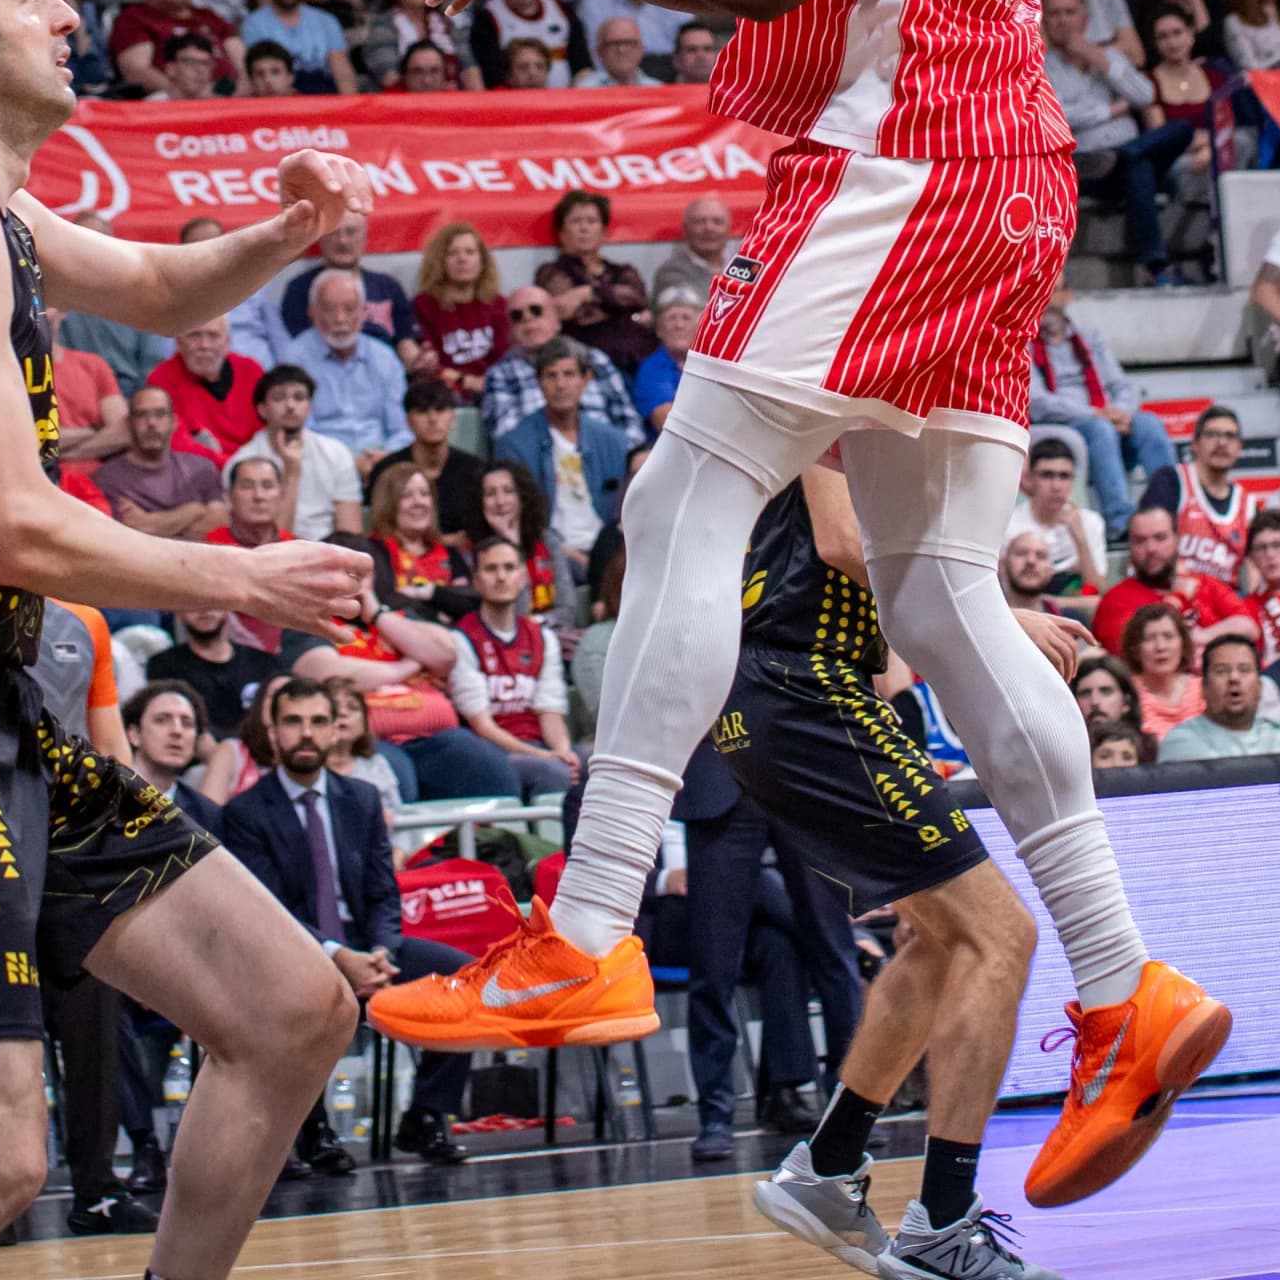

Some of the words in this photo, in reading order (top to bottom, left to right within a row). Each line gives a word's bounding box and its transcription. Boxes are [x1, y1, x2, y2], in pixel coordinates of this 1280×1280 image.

[154, 132, 248, 159] Costa
[252, 125, 350, 151] Cálida
[168, 161, 417, 206] REGN
[422, 158, 514, 193] DE
[520, 142, 768, 192] MURCIA
[728, 263, 752, 280] acb
